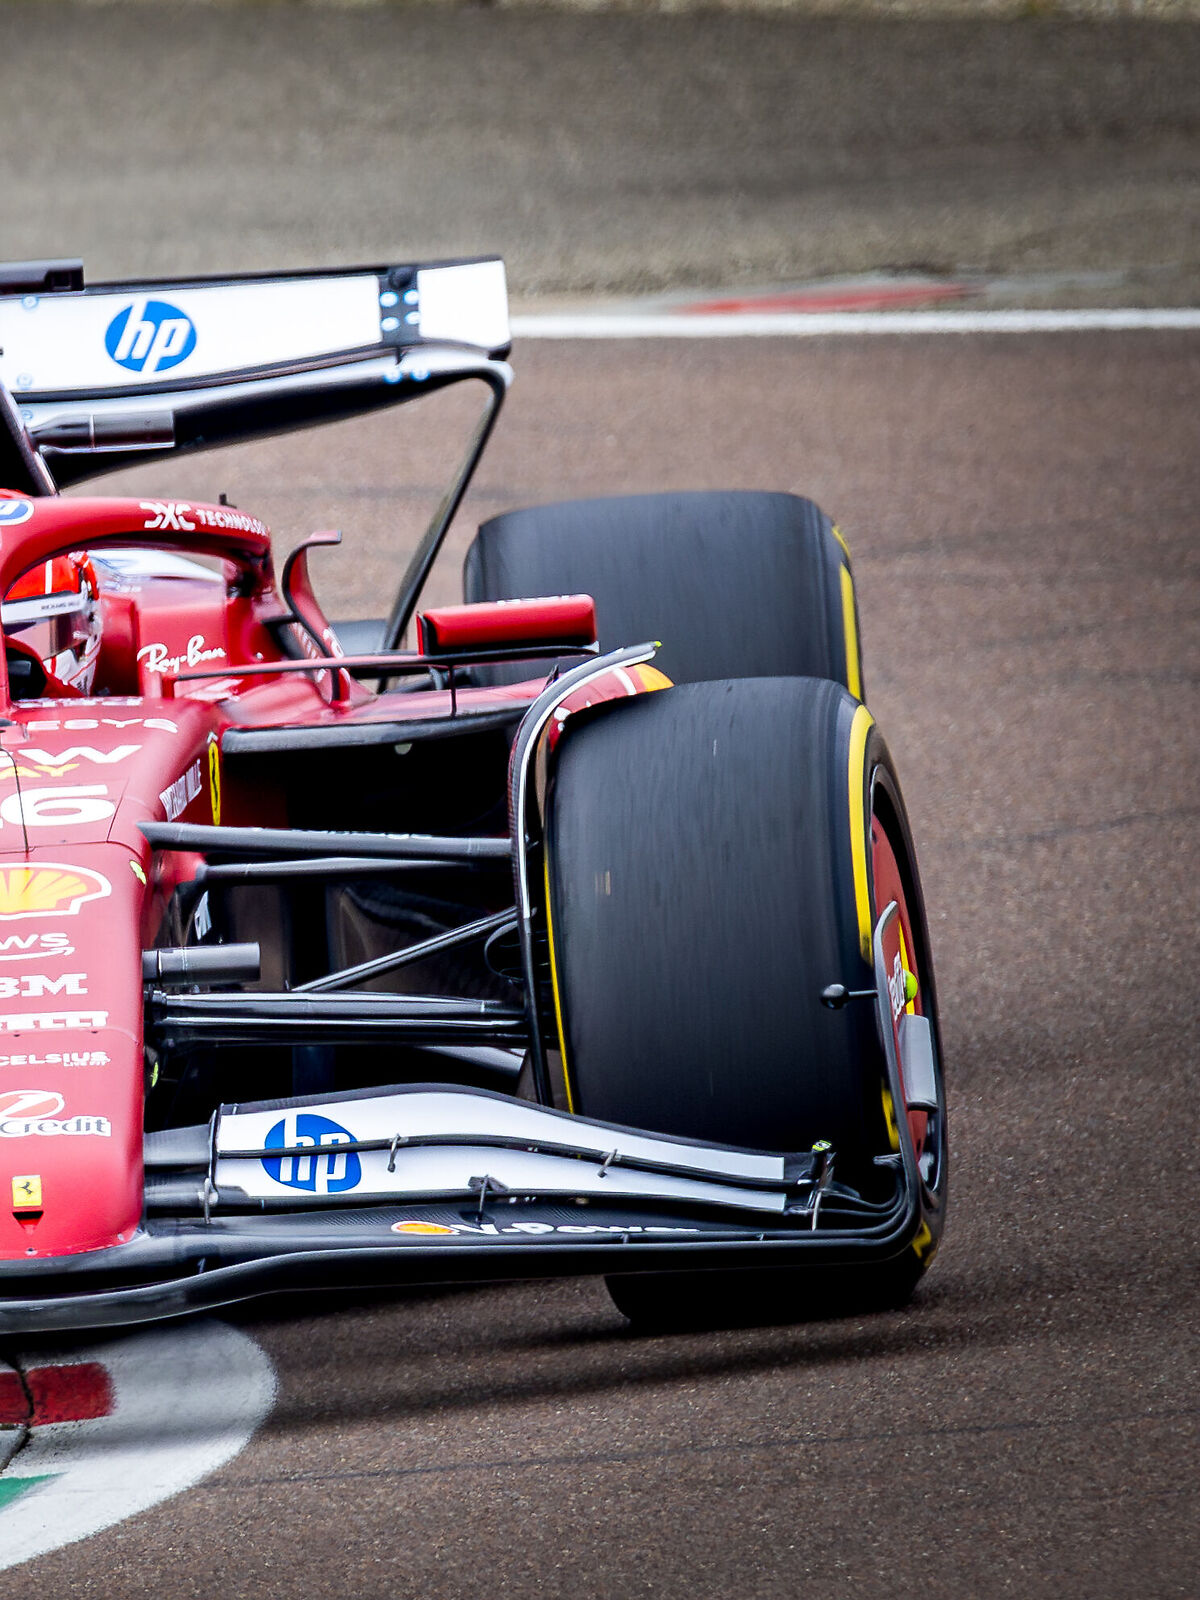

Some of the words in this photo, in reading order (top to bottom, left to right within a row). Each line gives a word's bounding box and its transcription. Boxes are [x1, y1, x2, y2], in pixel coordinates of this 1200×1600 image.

[108, 301, 194, 372] hp
[137, 635, 226, 673] Ray-Ban
[272, 1112, 357, 1193] hp
